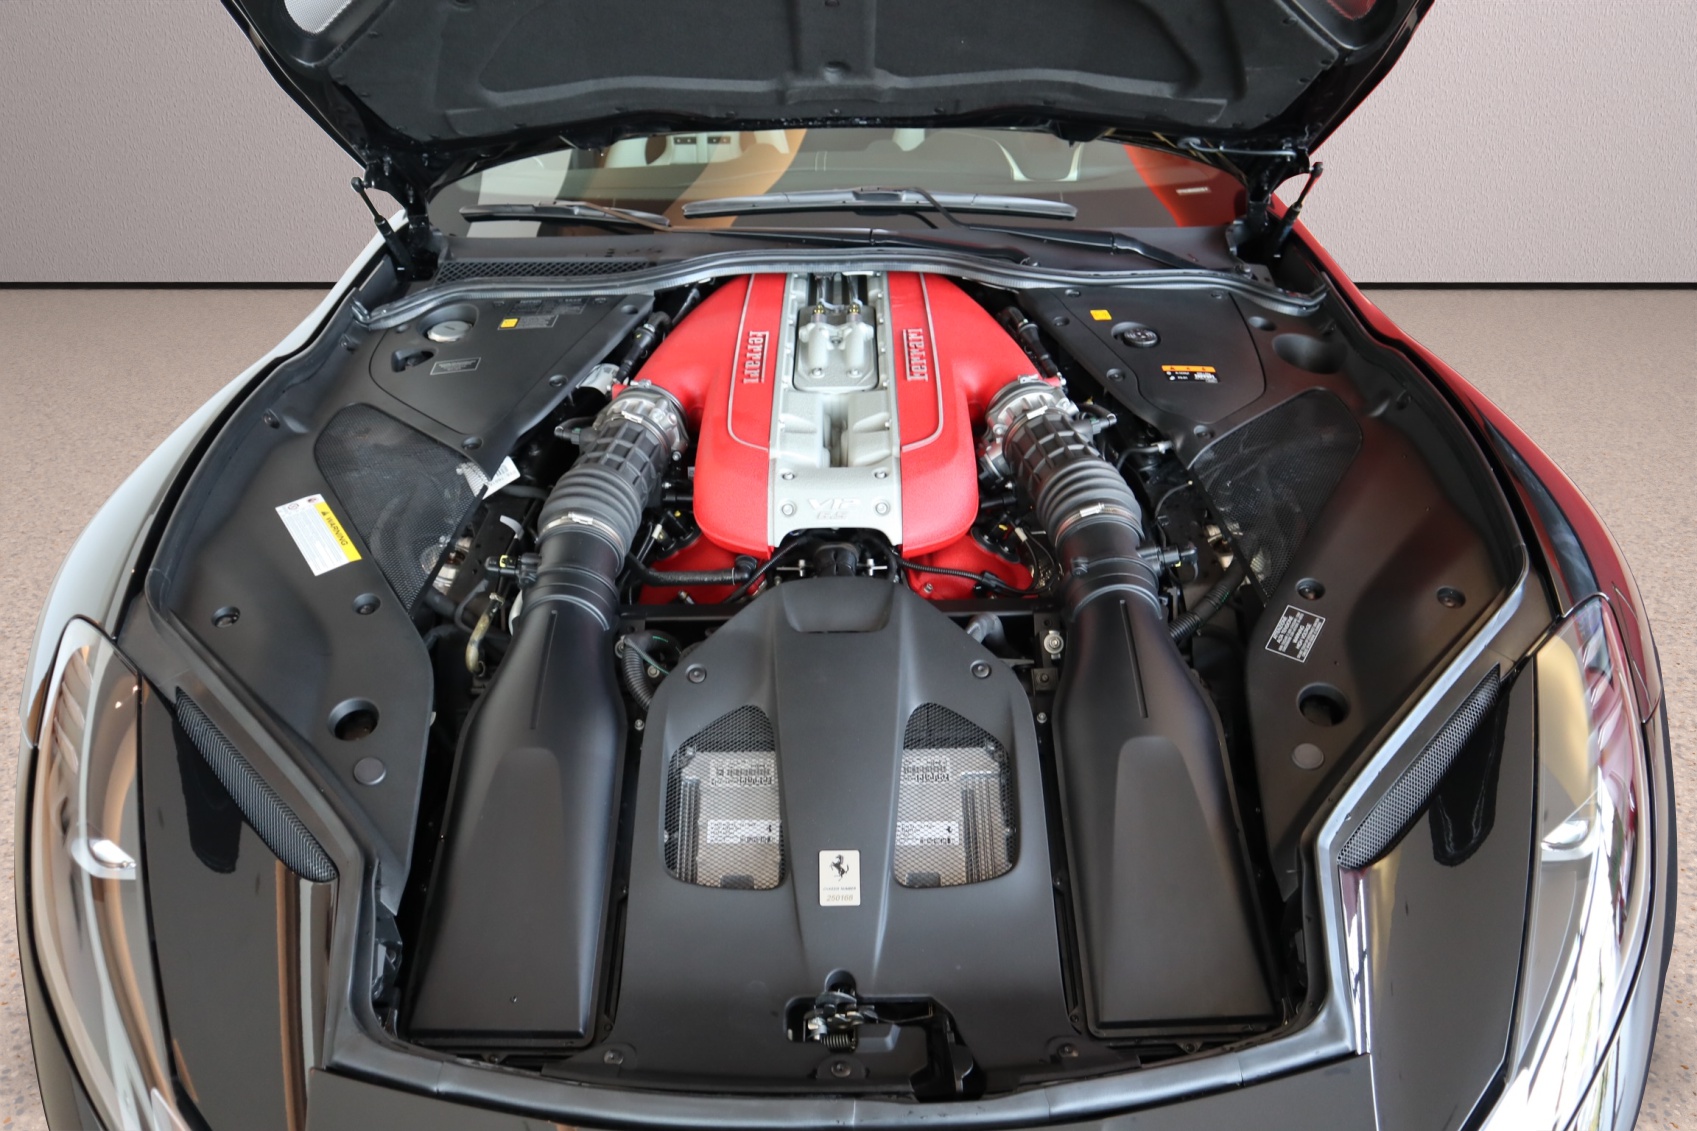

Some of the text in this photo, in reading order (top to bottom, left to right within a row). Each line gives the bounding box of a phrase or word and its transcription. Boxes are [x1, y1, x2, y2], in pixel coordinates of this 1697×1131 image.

[742, 331, 769, 384] Ferrari
[903, 328, 928, 382] Ferrari
[807, 498, 859, 511] V12
[326, 516, 349, 546] WARNING
